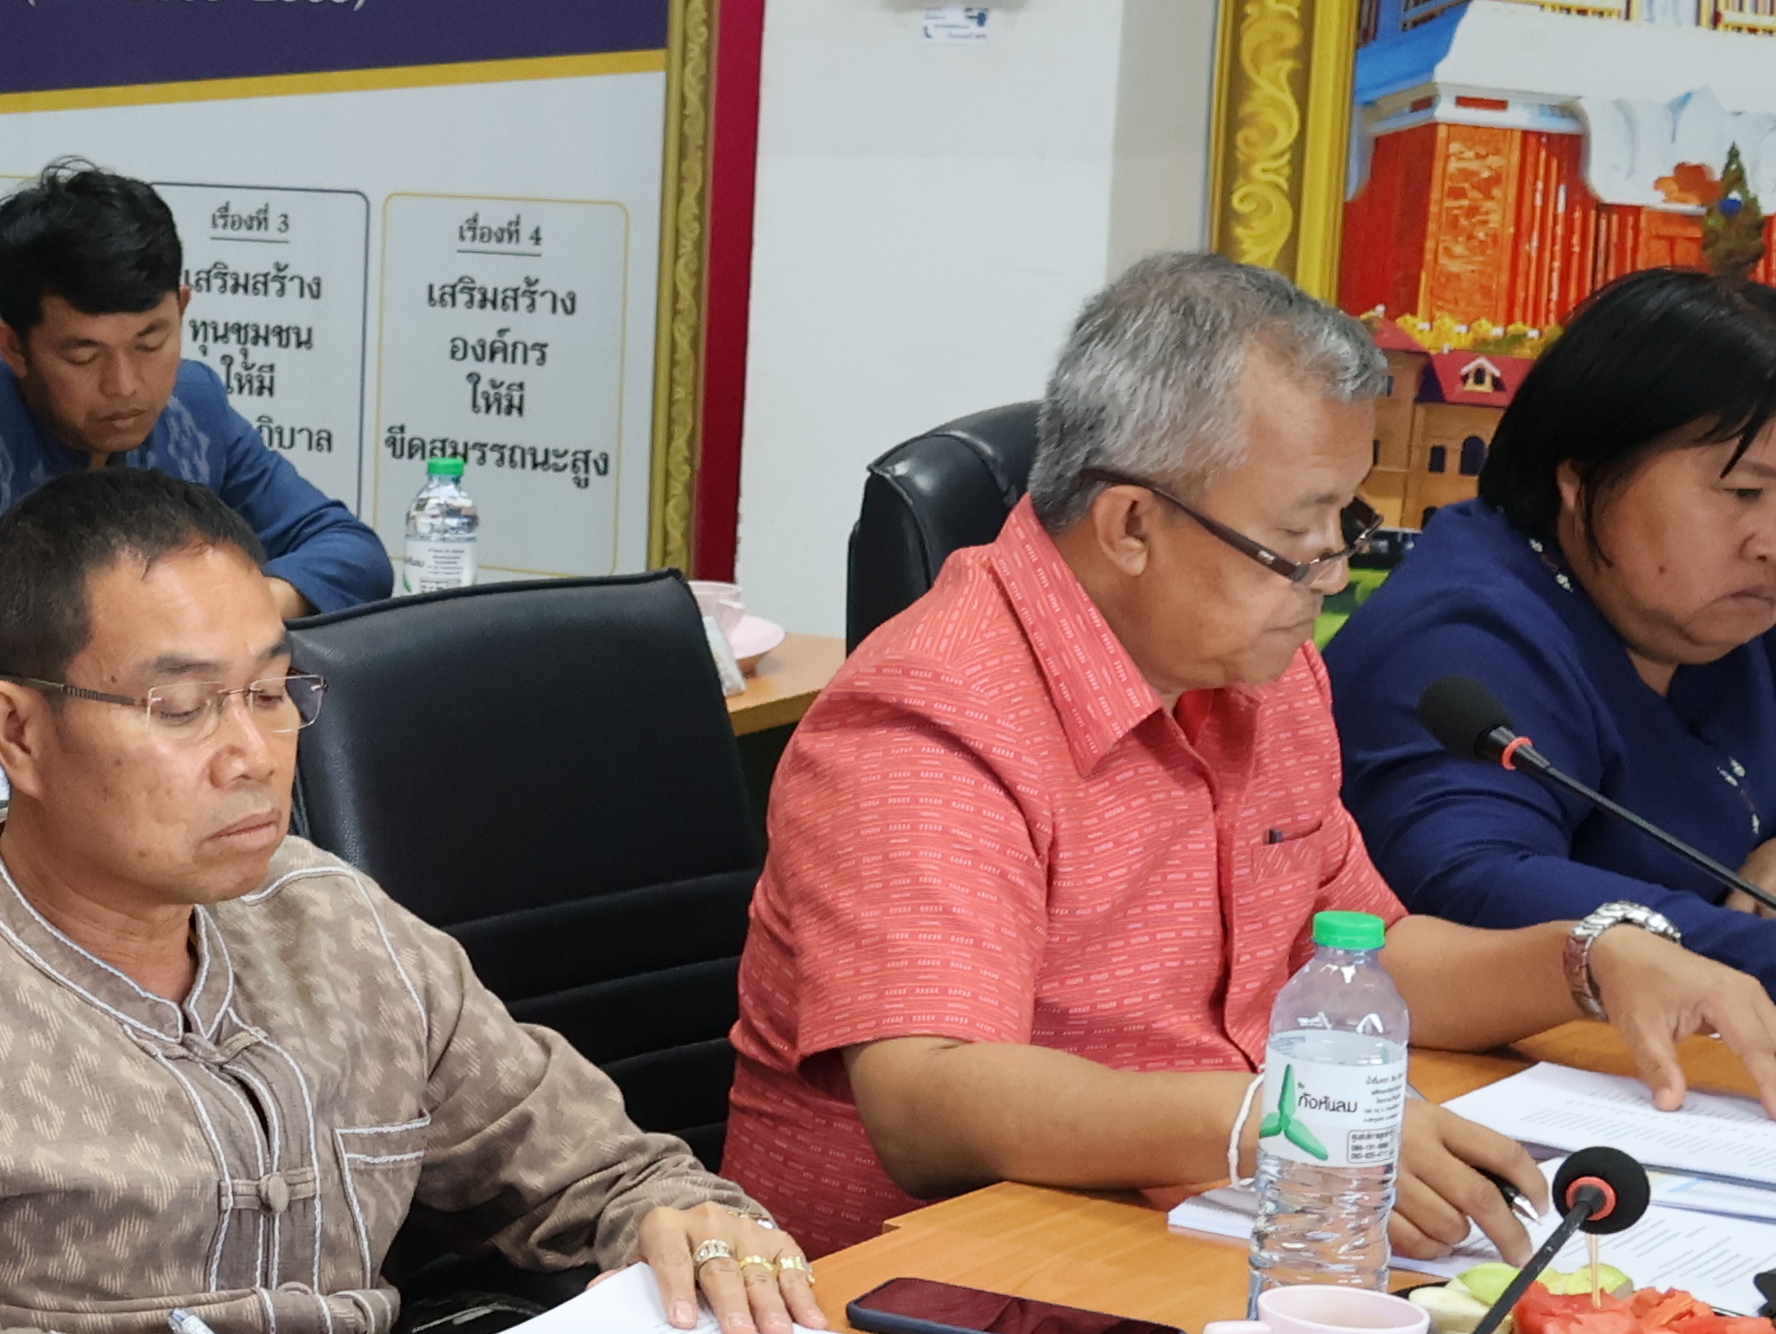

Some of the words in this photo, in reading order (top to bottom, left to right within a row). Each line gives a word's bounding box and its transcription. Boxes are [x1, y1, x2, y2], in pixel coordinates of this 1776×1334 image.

[210, 202, 271, 234] เรื่องที่
[276, 213, 290, 234] 3
[458, 212, 521, 246] เรื่องที่
[528, 225, 543, 247] 4
[183, 261, 323, 301] เสริมสร้าง
[426, 275, 578, 317] เสริมสร้าง
[188, 317, 314, 360] ทุนชุมชน
[450, 327, 550, 368] องค์กร
[219, 354, 276, 399] ให้มี
[466, 373, 526, 418] ให้มี
[383, 423, 611, 490] ขีดสมรรถนะสูง
